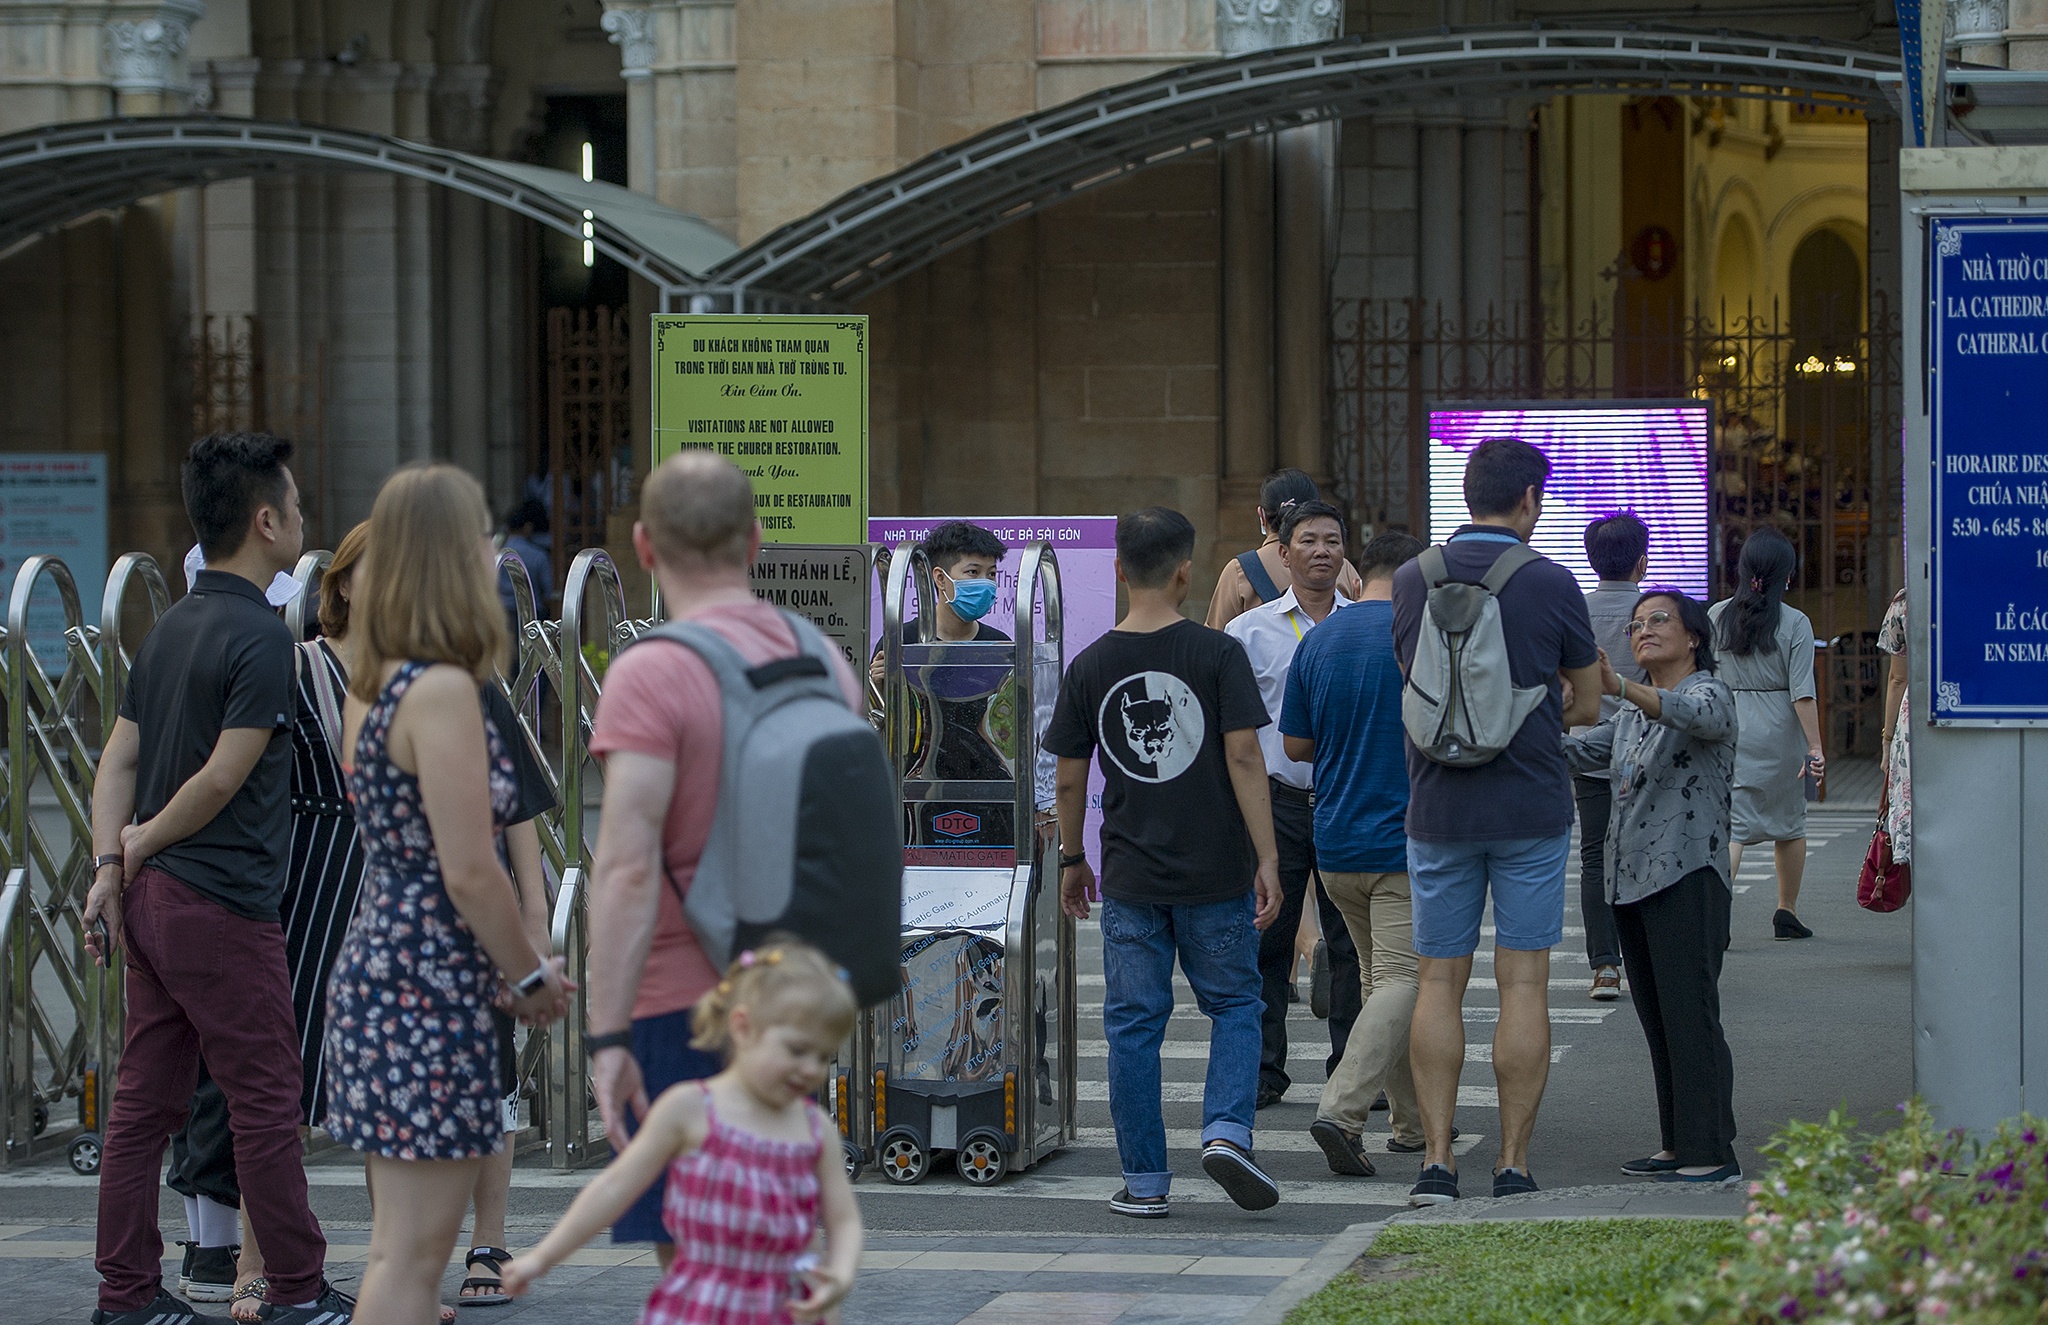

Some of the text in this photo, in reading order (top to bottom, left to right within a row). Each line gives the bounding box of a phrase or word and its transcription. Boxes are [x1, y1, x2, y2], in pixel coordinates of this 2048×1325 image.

[1962, 252, 1995, 281] NHÀ
[1997, 252, 2030, 281] THỜ
[1947, 296, 1968, 318] LA
[693, 337, 830, 355] DU KHÁCH KHÔNG THAM QUAN
[1957, 332, 2039, 355] CATHERAL
[674, 358, 847, 376] TRONG THỜI GIAN NHÀ THỜ TRÙNG TU.
[720, 383, 802, 397] Xin Cảm Ơn.
[688, 420, 834, 434] VISITATIONS ARE NOT ALLOWED
[717, 442, 735, 456] THE
[737, 442, 773, 456] CHURCH
[775, 442, 841, 456] RESTORATION.
[768, 464, 800, 480] You.
[1946, 454, 2048, 474] HORAIRE DES
[774, 494, 785, 508] DE
[787, 494, 852, 508] RESTAURATION
[1968, 480, 2048, 510] CHÚA NHẬ
[760, 516, 796, 530] VISITES.
[1952, 518, 1981, 537] 5:30
[1992, 518, 2021, 537] 6:45
[884, 528, 907, 541] NHÀ
[1018, 528, 1033, 541] BÀ
[1036, 528, 1055, 541] SÀI
[1058, 528, 1081, 541] GÒN
[780, 559, 829, 580] THÁNH
[834, 556, 857, 585] LỄ,
[752, 589, 833, 609] HAM QUAN.
[828, 612, 848, 627] Ơn.
[1995, 603, 2016, 630] LỄ
[1984, 643, 2005, 662] EN
[942, 818, 973, 829] DTC
[977, 851, 1008, 861] GATE
[932, 900, 955, 914] Gate
[944, 915, 967, 930] DTC
[967, 892, 1011, 920] Automatic
[914, 935, 936, 952] Gate
[929, 954, 951, 972] DTC
[978, 951, 999, 969] Gate
[964, 1054, 985, 1072] DTC
